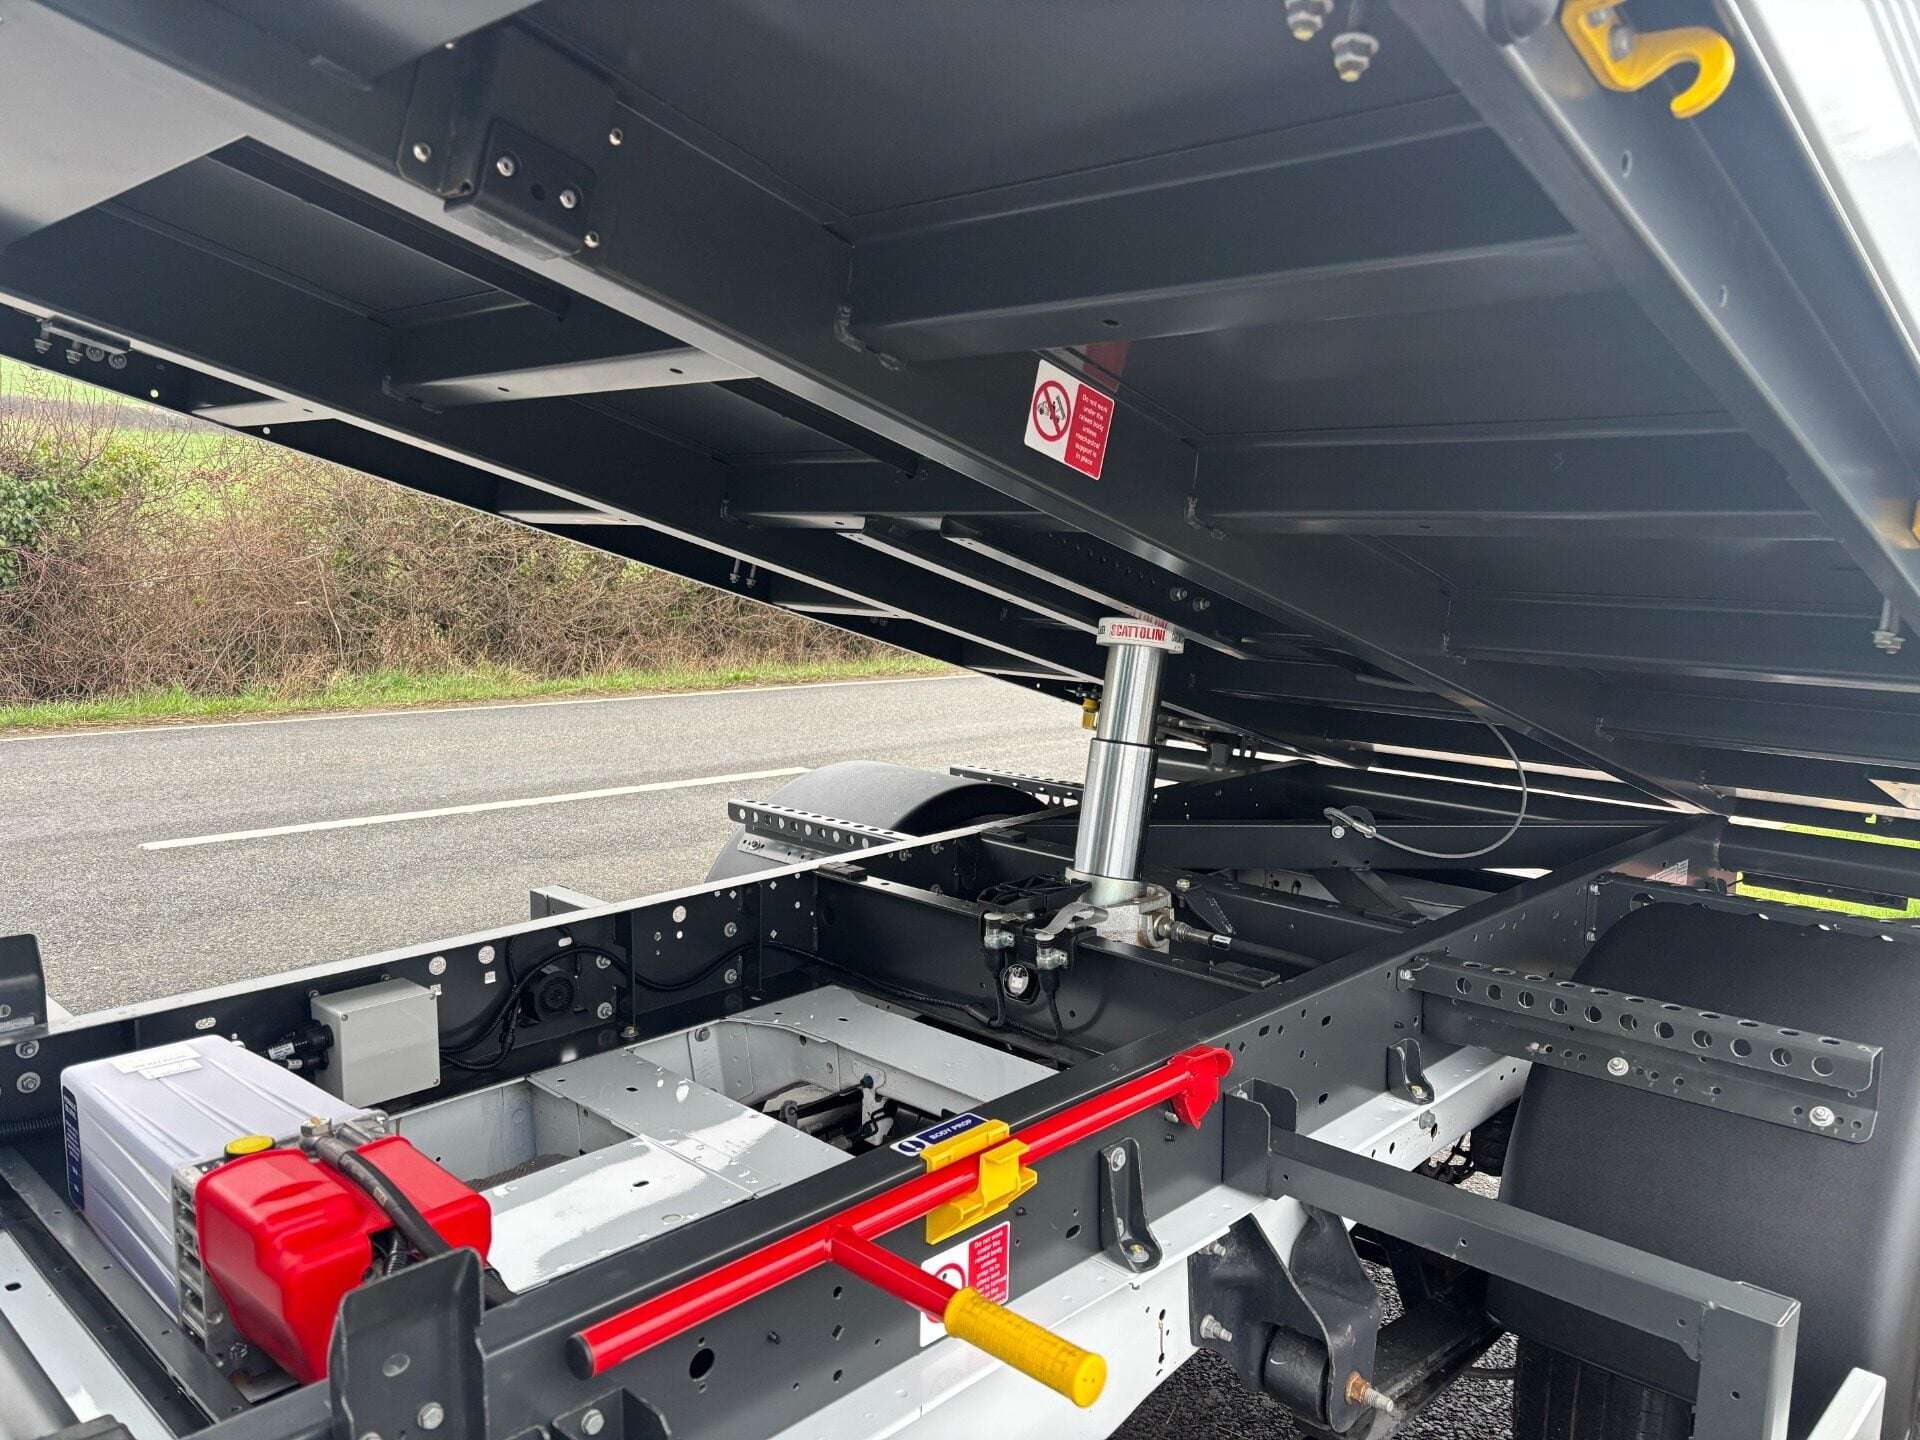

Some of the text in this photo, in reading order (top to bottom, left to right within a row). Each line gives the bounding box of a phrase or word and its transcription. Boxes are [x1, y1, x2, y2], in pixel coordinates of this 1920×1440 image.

[1082, 393, 1089, 403] Do
[1110, 624, 1166, 641] SCATTOLINI
[928, 1118, 972, 1140] BODY PROP
[974, 1241, 982, 1249] Do
[982, 1237, 991, 1245] not
